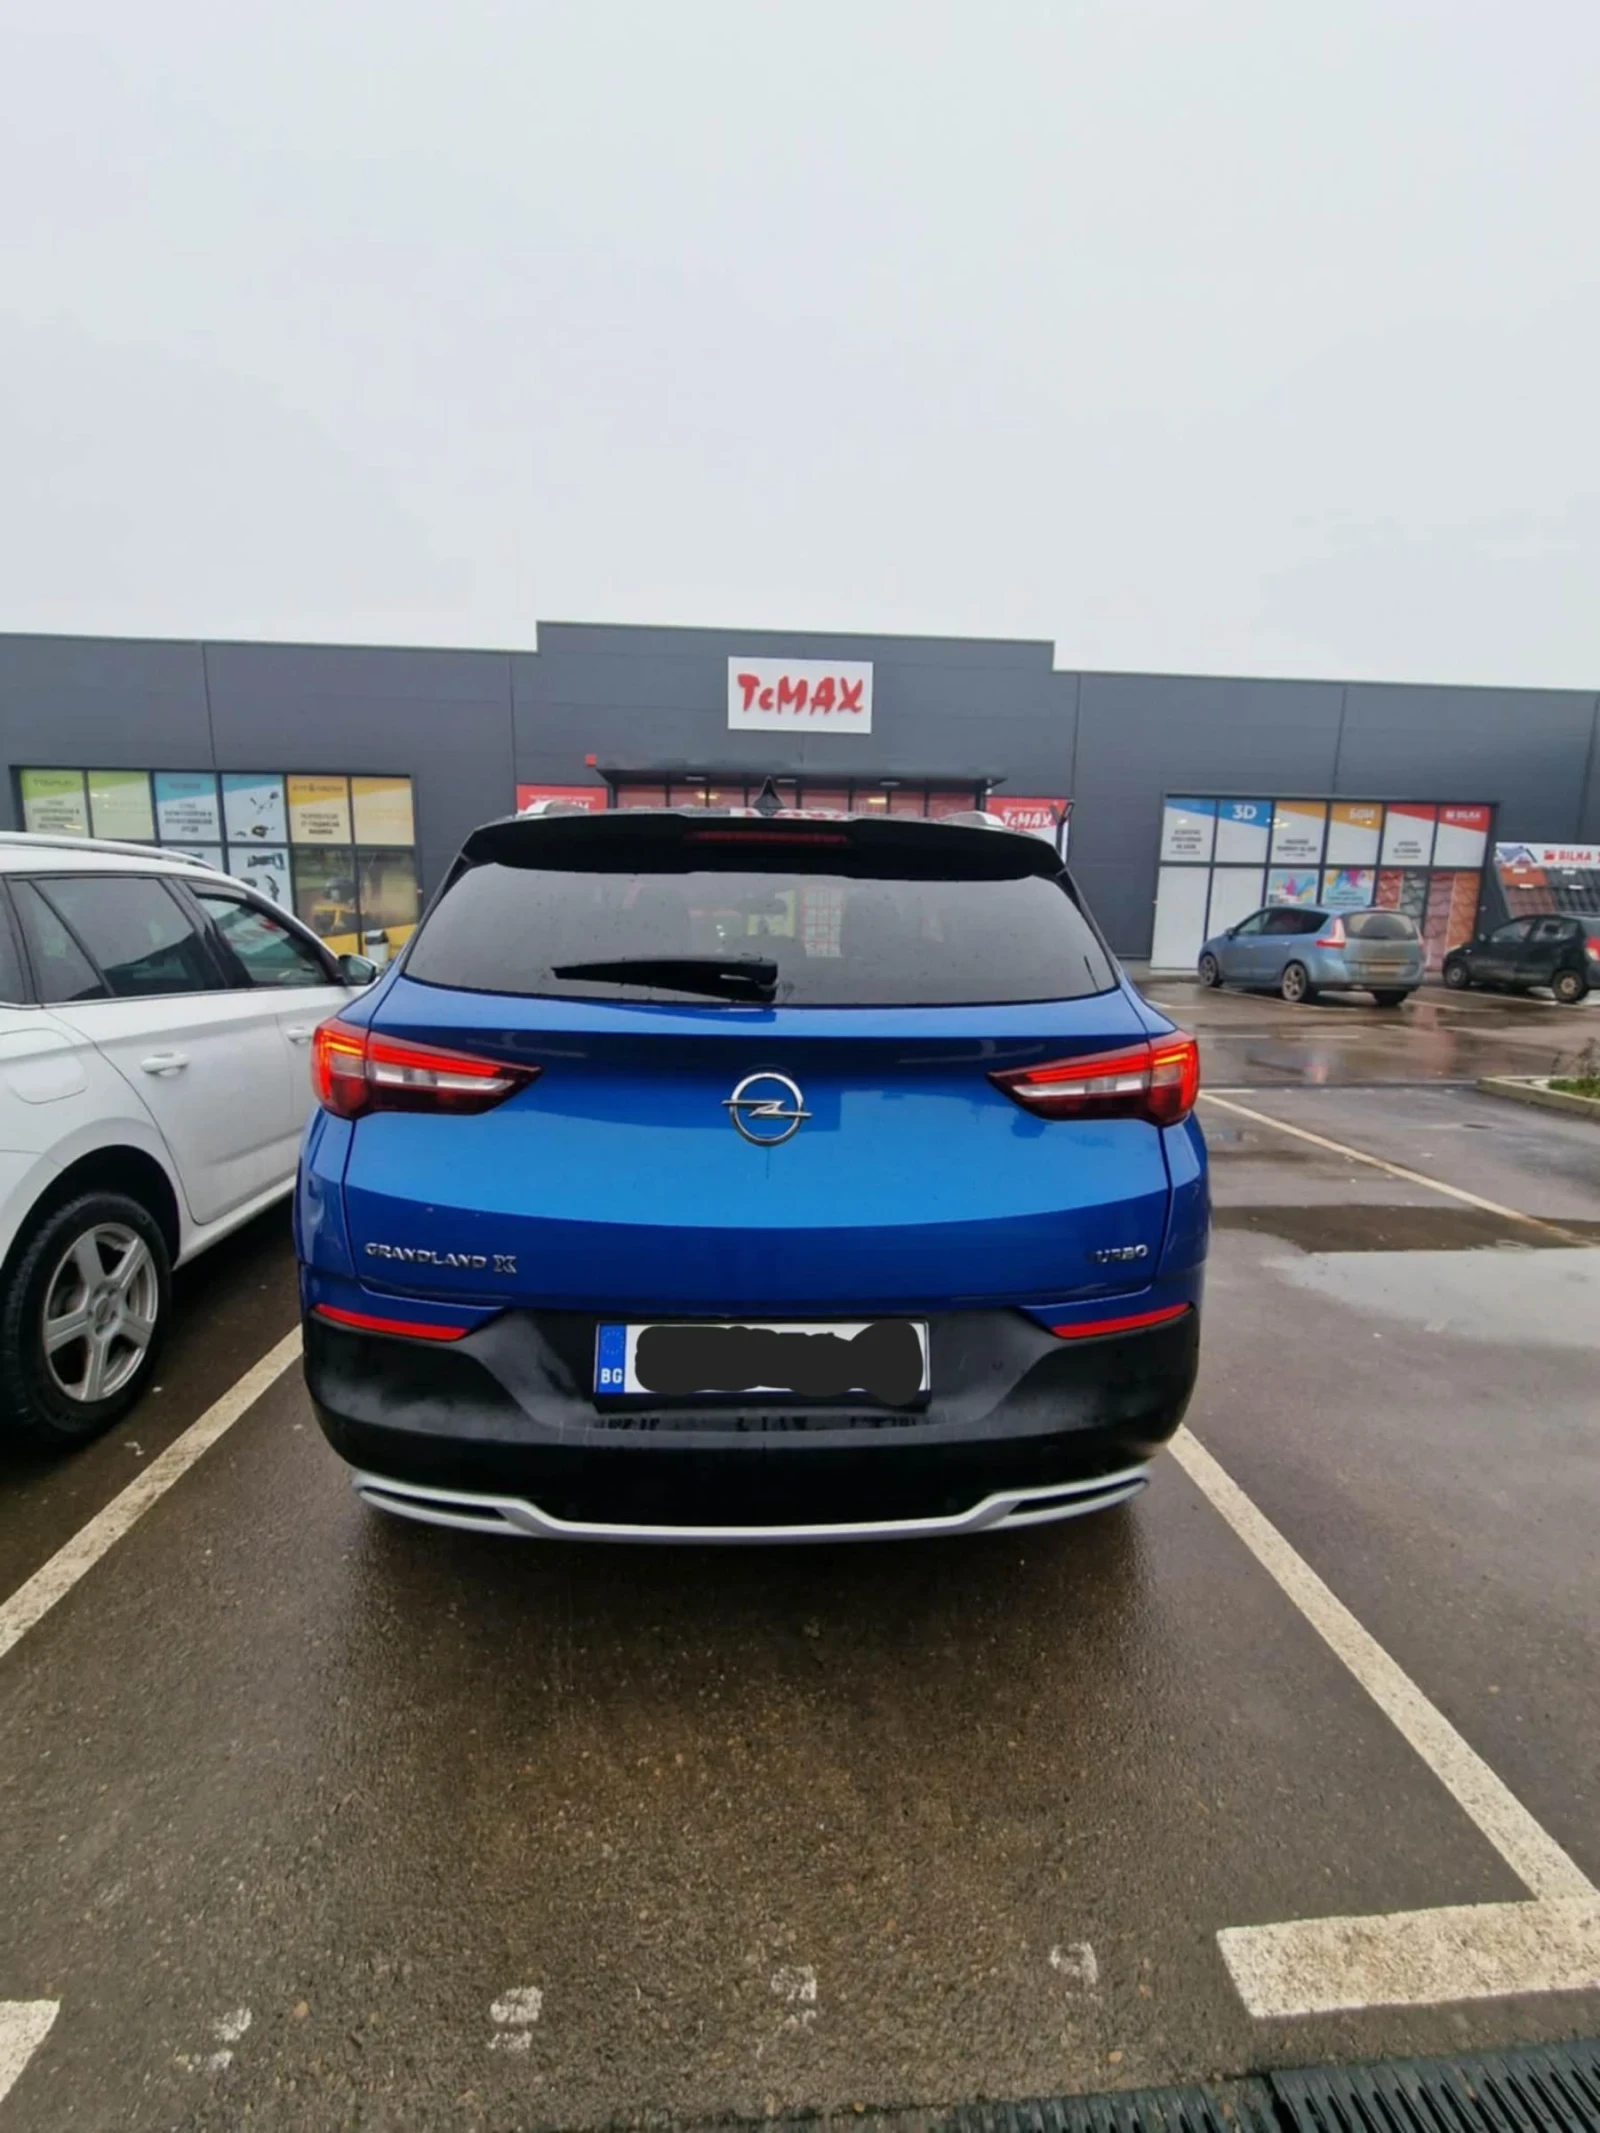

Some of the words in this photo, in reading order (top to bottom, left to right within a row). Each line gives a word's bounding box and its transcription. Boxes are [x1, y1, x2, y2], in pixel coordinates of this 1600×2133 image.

[1232, 804, 1257, 819] 3D
[1558, 850, 1592, 861] BILKA
[366, 1242, 487, 1269] GRANDLAND
[493, 1254, 518, 1273] X
[600, 1368, 623, 1384] BG
